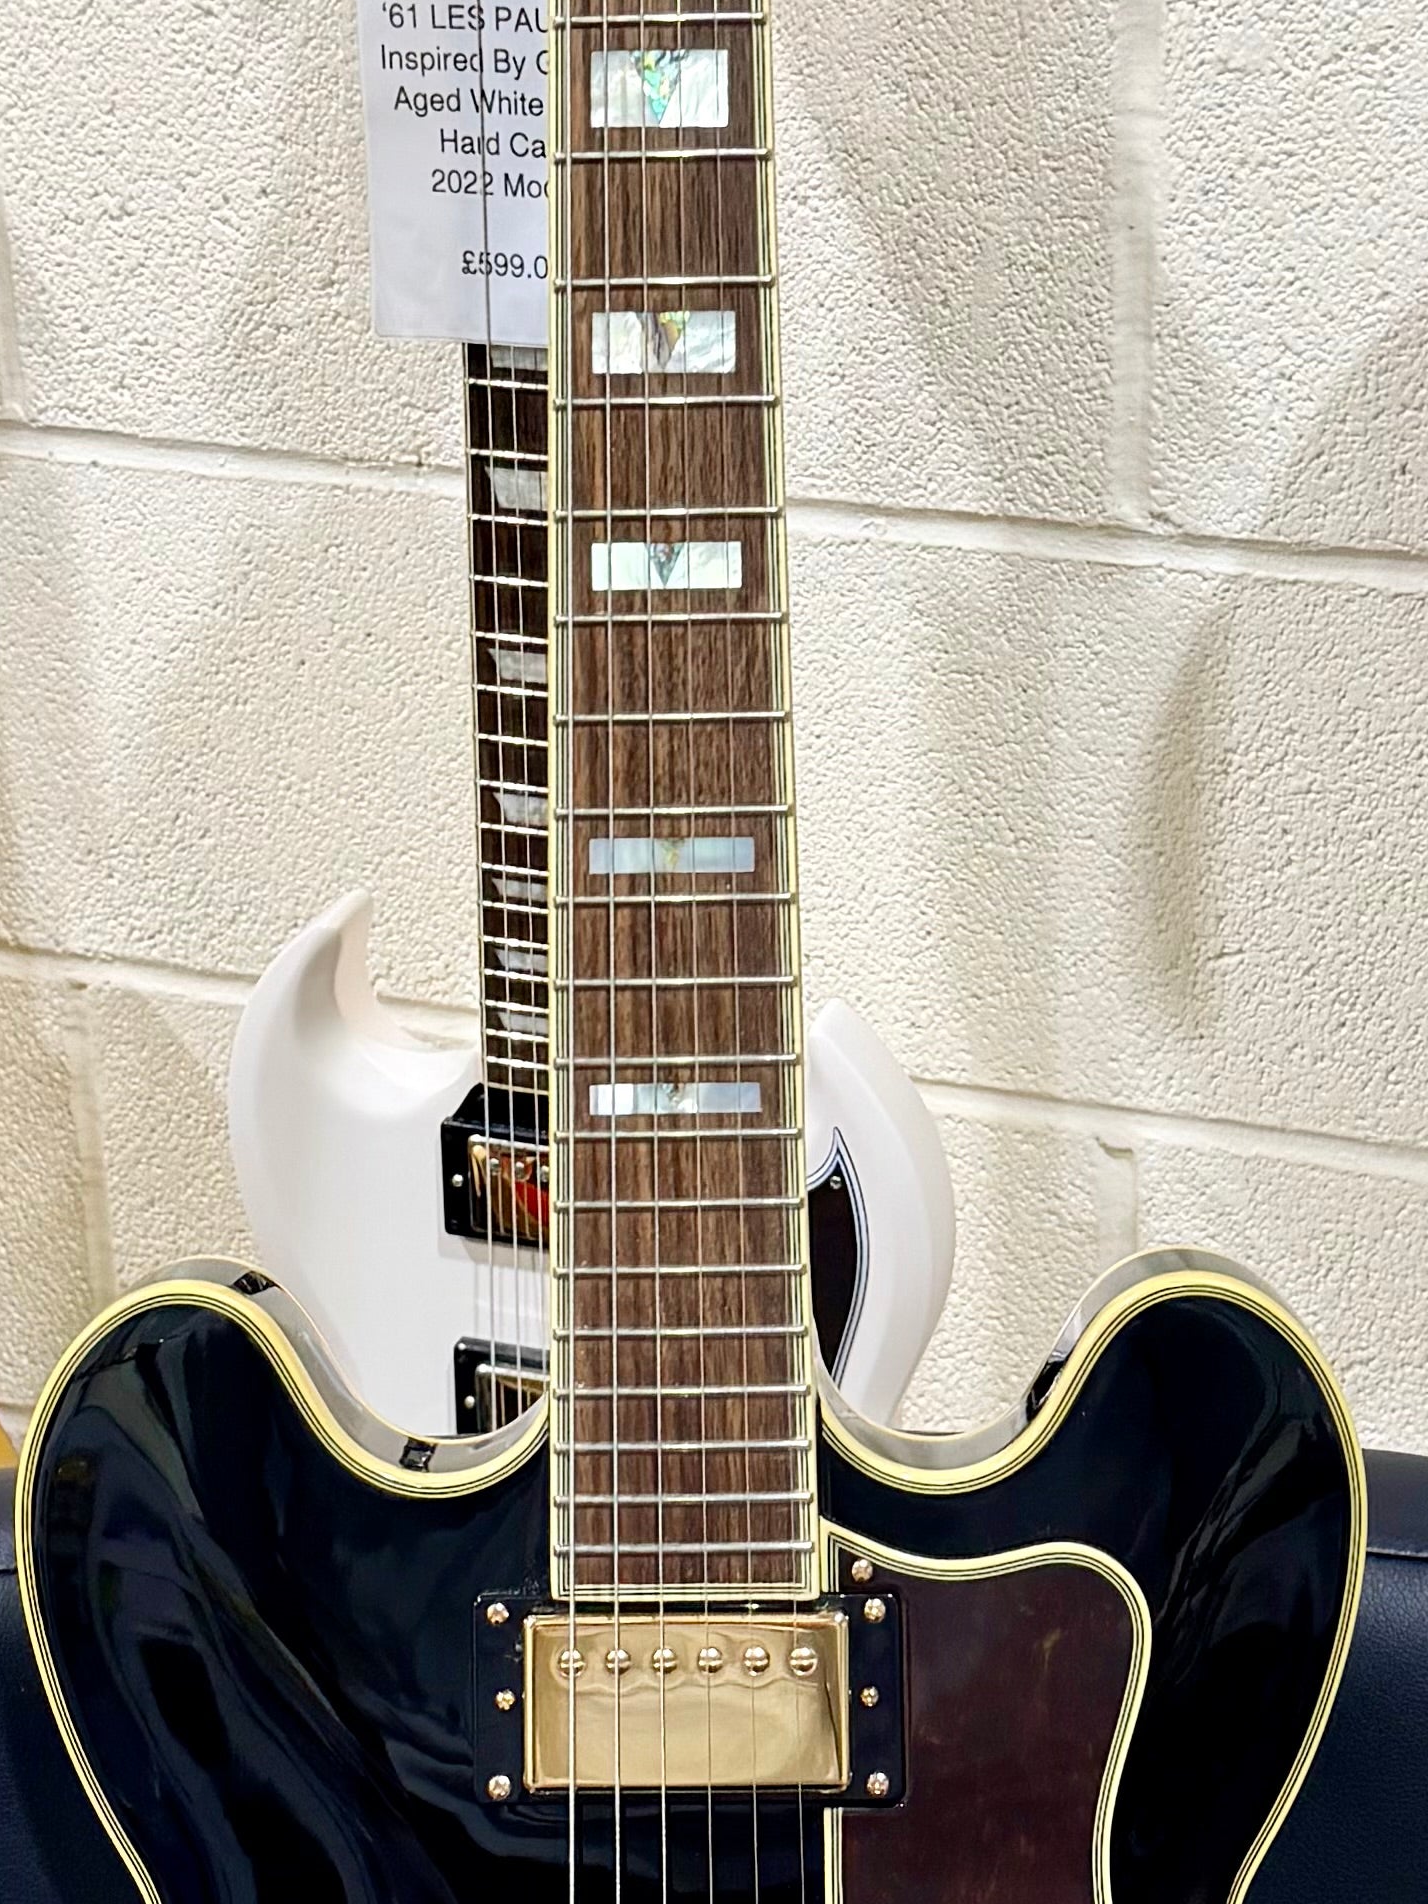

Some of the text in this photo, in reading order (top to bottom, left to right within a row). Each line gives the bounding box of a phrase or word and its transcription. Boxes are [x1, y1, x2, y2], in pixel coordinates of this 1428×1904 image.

[430, 4, 485, 31] LES
[380, 44, 483, 77] Inspired
[493, 48, 526, 80] By
[394, 86, 544, 117] Aged White
[440, 128, 500, 156] Hard
[432, 169, 494, 196] 2022
